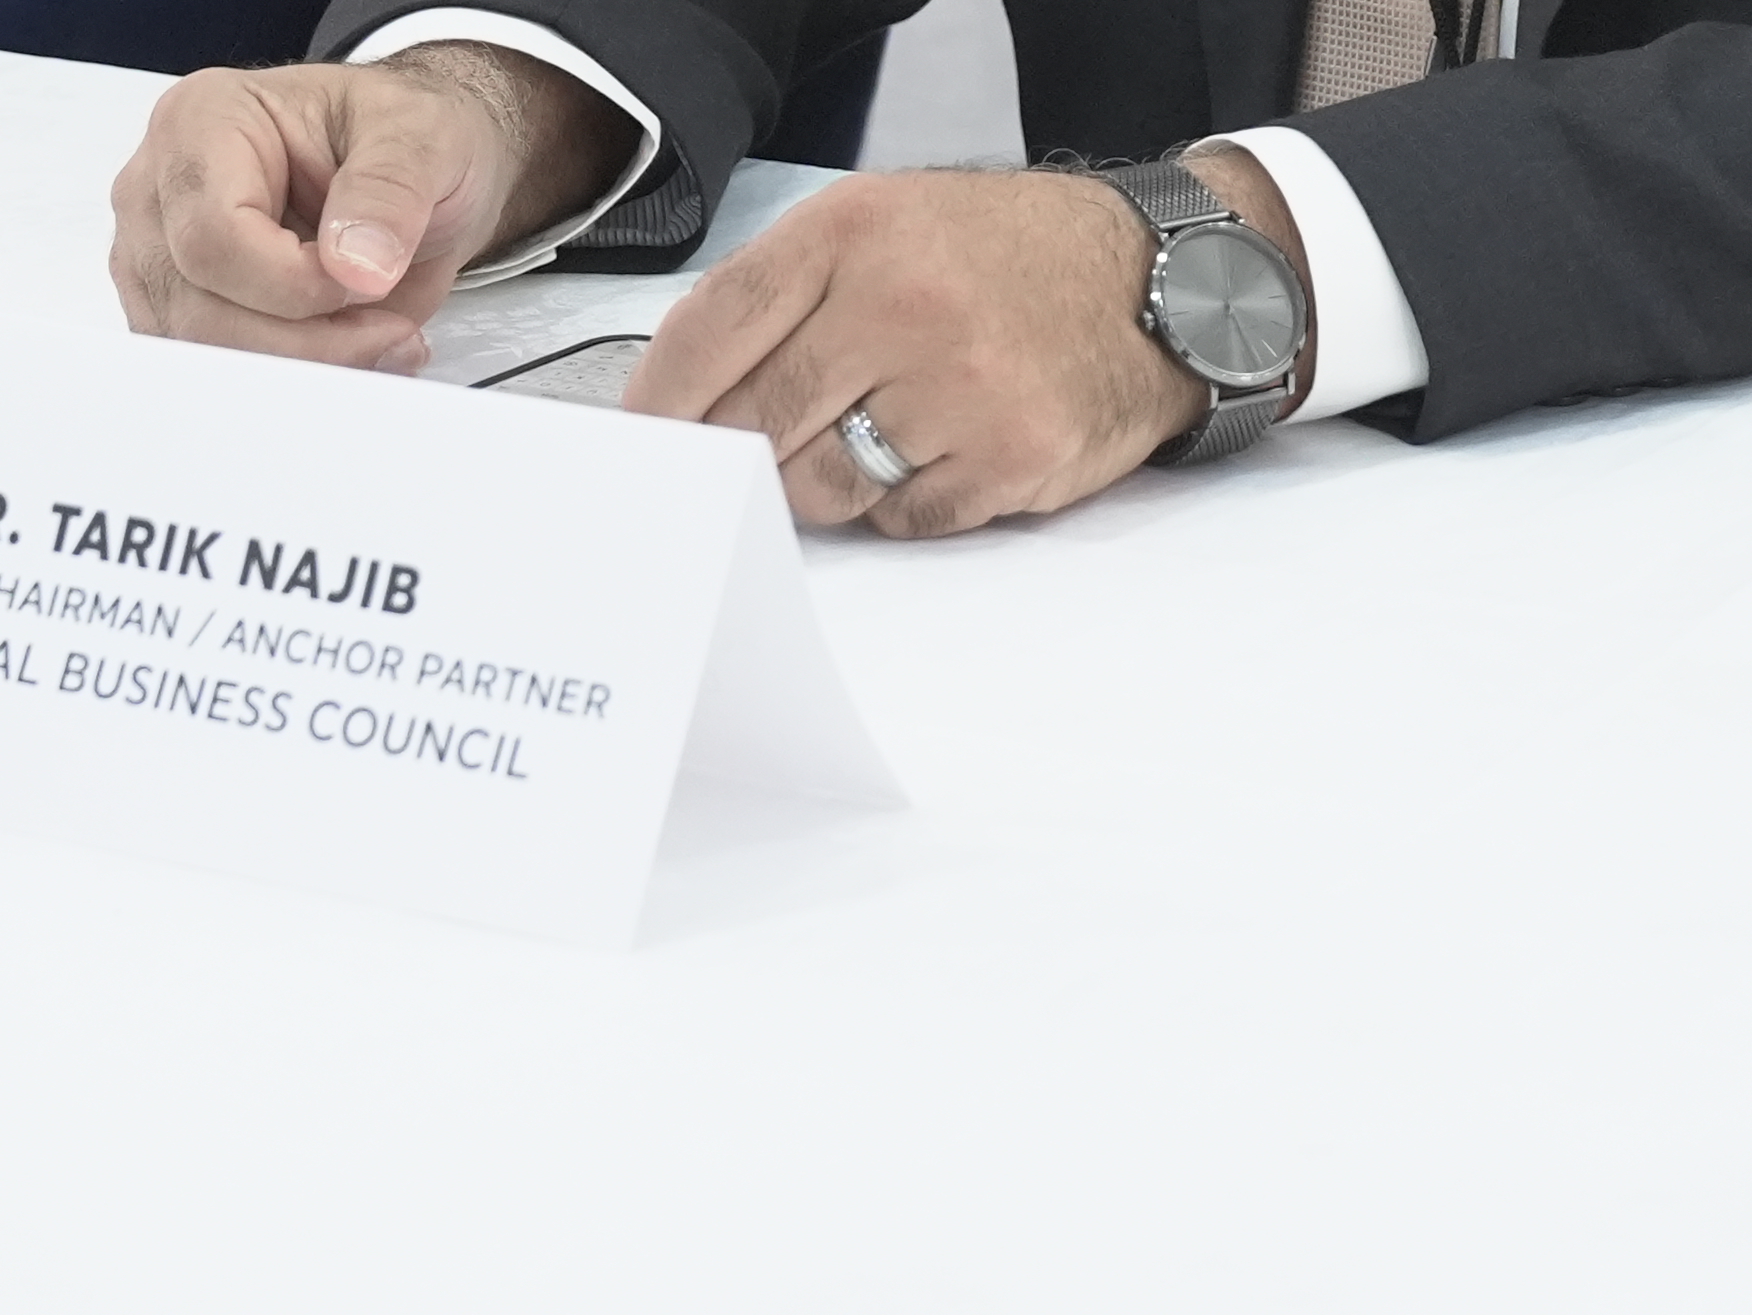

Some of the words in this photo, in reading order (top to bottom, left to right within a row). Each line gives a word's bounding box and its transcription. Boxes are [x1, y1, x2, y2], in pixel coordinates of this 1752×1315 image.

[50, 501, 223, 582] TARIK
[237, 536, 422, 617] NAJIB
[58, 651, 293, 733] BUSINESS
[307, 699, 528, 780] COUNCIL
[188, 611, 216, 647] /
[221, 618, 404, 681] ANCHOR
[416, 652, 611, 719] PARTNER
